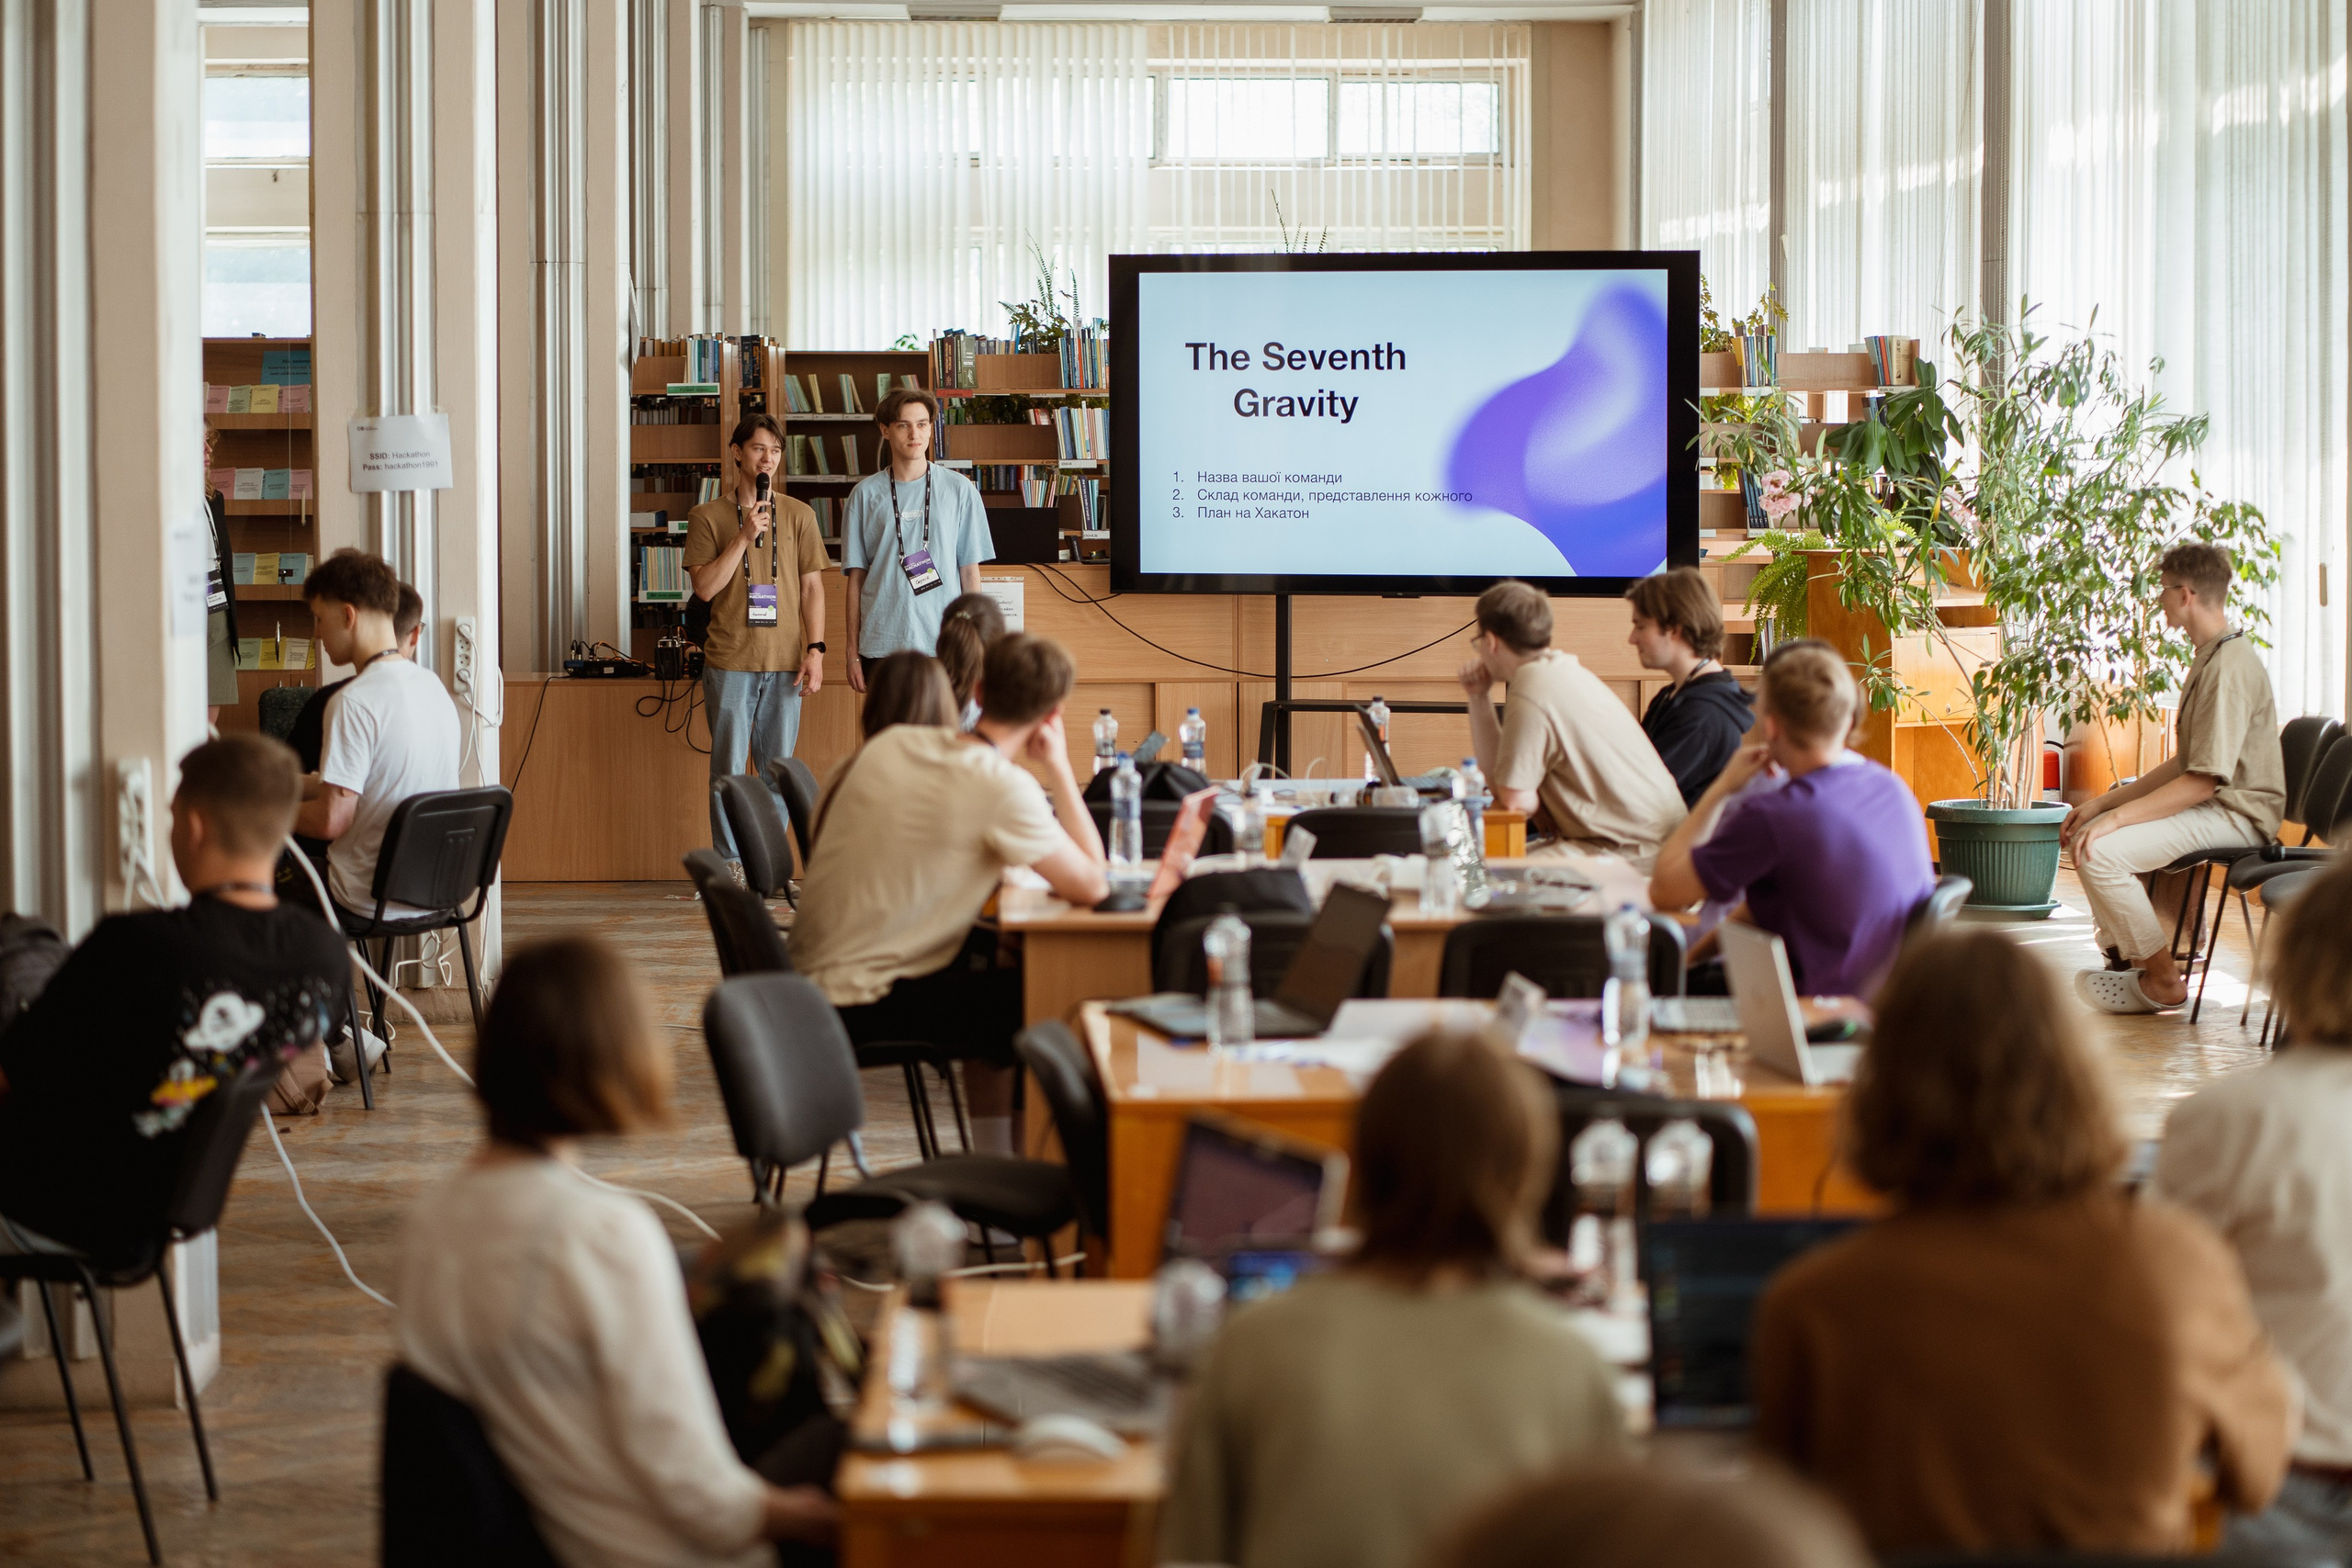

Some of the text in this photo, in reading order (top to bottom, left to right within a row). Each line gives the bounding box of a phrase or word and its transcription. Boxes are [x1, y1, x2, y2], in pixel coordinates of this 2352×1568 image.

[1185, 341, 1407, 371] The Seventh
[1234, 388, 1359, 424] Gravity
[369, 451, 431, 460] SSID: Hackathon
[362, 460, 438, 471] Pass: hackathon1991
[1172, 471, 1342, 486] 1. Назва вашої команди
[1172, 489, 1474, 504] 2. Склад команди, представлення кожного
[1172, 506, 1309, 519] 3. План на Хакатон
